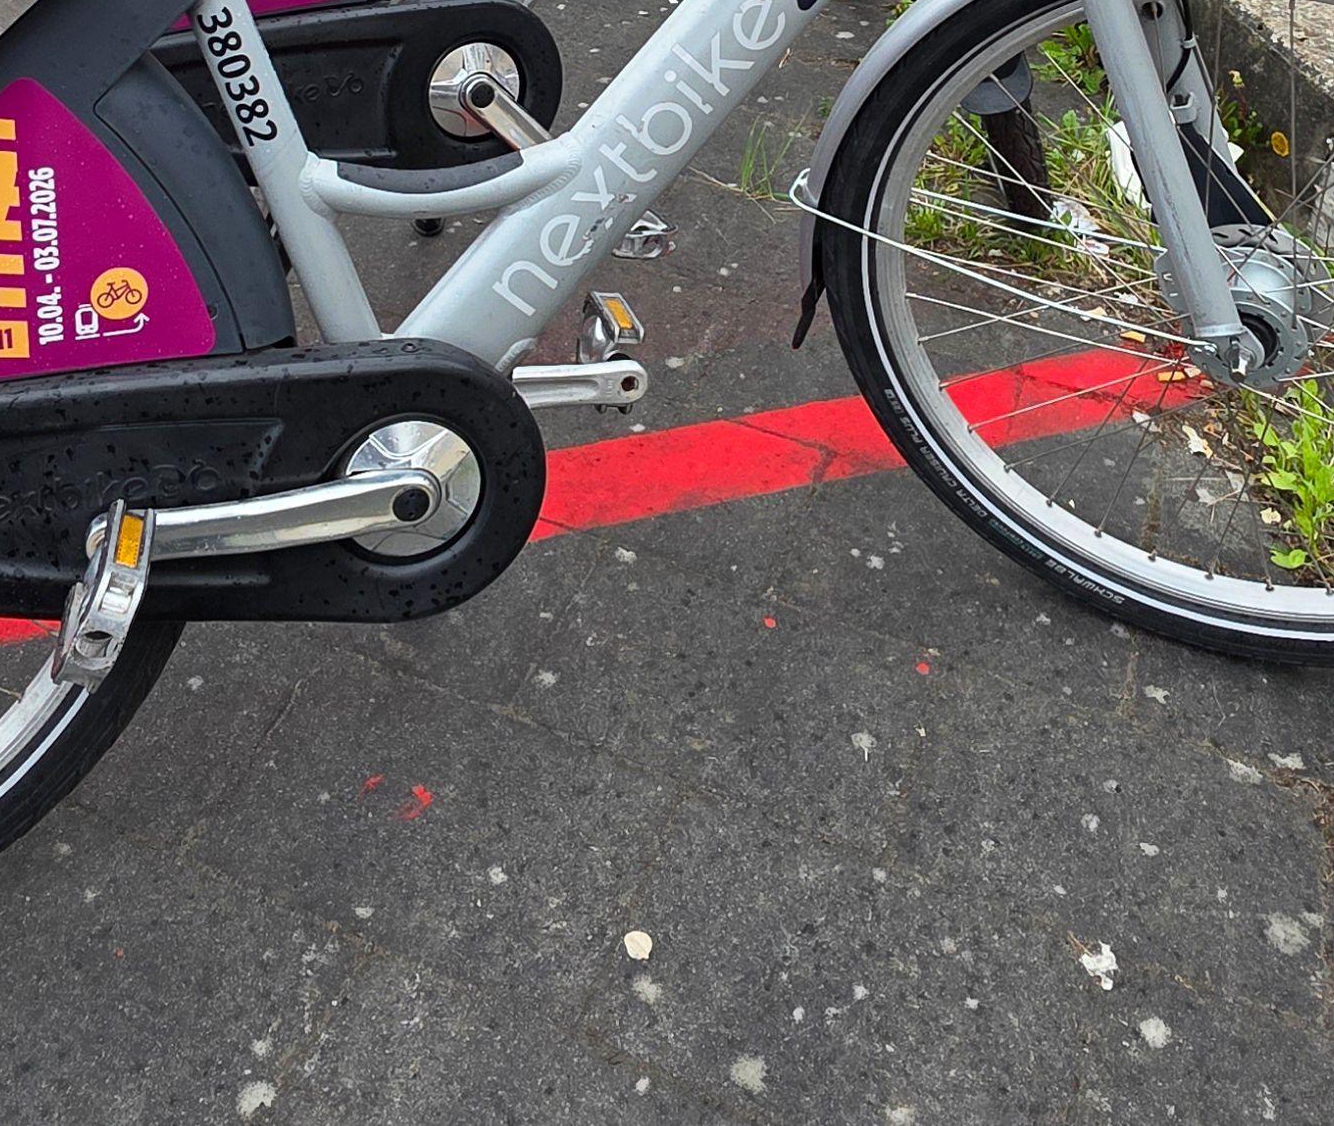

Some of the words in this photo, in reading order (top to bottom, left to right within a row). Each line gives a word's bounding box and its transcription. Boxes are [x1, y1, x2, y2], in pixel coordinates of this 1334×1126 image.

[197, 6, 278, 147] 380382
[28, 166, 60, 271] 03.07.2026
[36, 286, 64, 346] 10.04.
[899, 416, 923, 445] PLUS
[920, 446, 957, 488] CRUISER
[956, 488, 988, 519] DELTA
[1044, 557, 1126, 605] SCHWALBE
